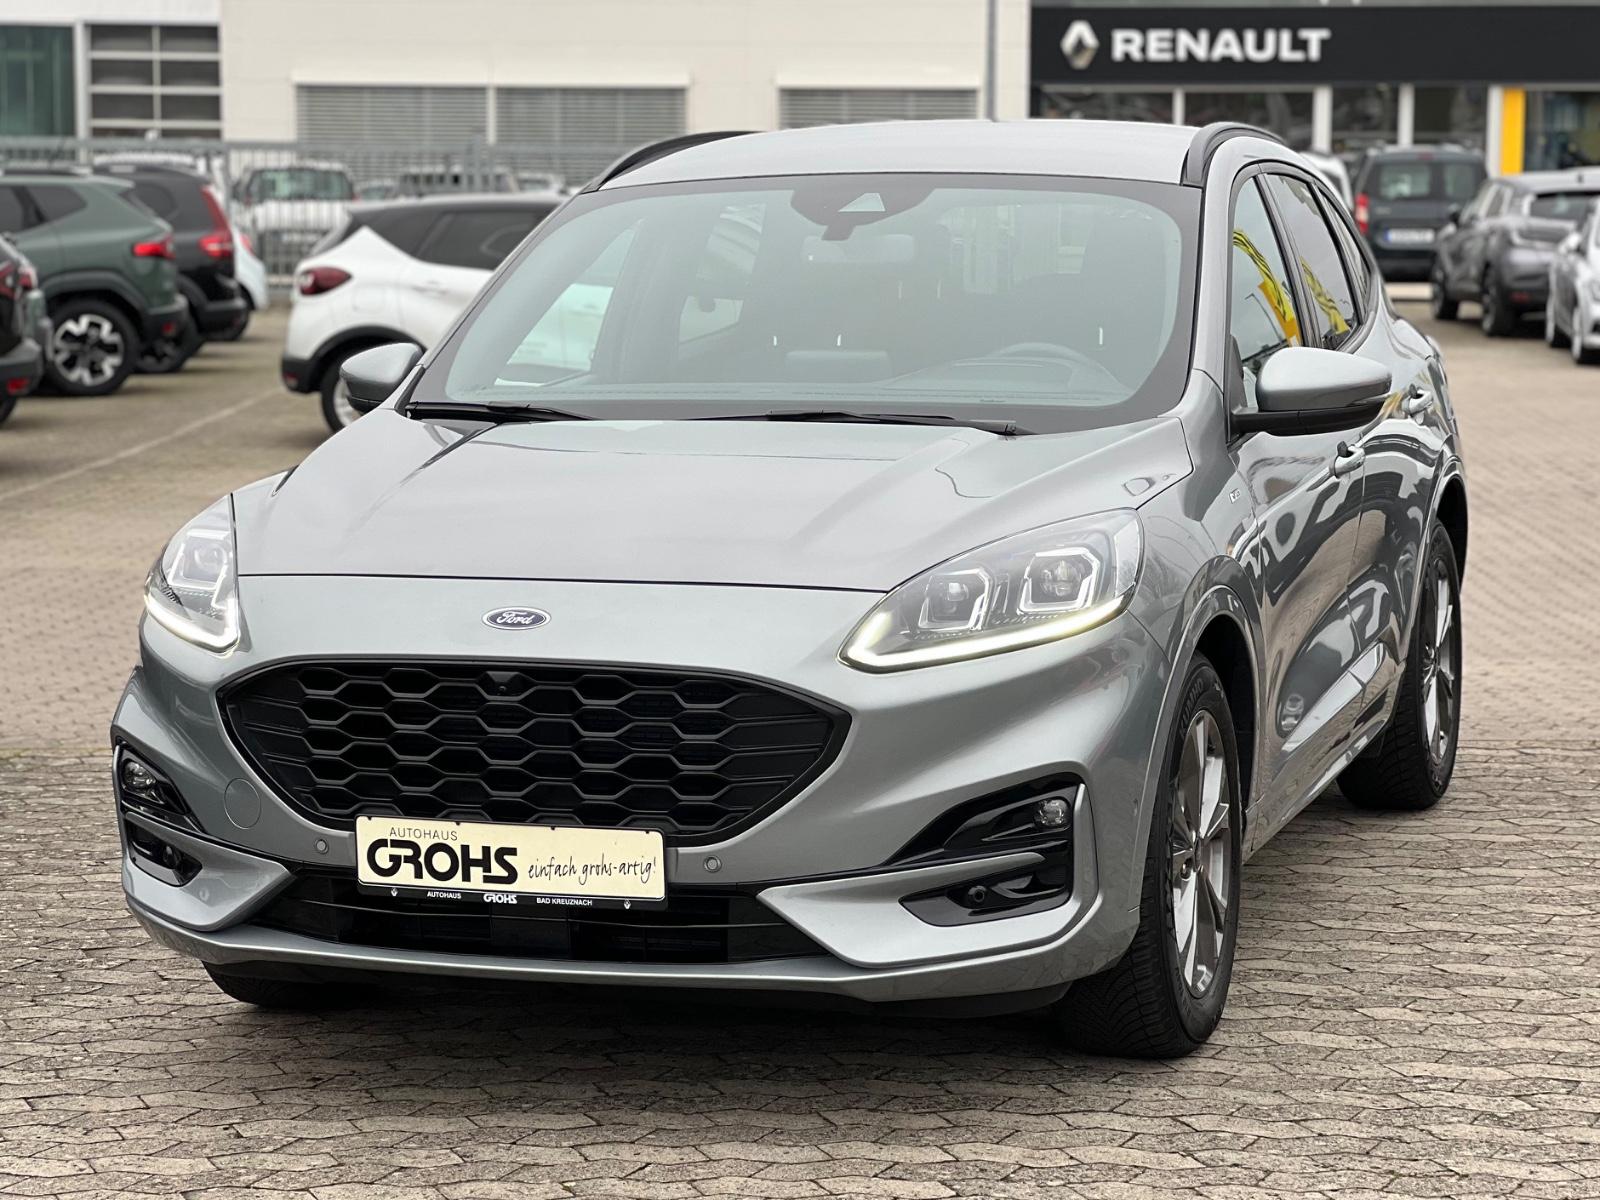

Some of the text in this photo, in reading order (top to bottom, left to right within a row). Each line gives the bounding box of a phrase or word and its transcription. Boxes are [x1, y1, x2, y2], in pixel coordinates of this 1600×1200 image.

[1111, 29, 1331, 62] RENAULT
[496, 611, 536, 625] Ford
[389, 827, 458, 841] AUTOHAUS
[367, 838, 518, 885] GROHS
[528, 852, 657, 885] einfach grohs-artig!
[427, 891, 461, 899] AUTOHAUS
[483, 893, 517, 904] GROHS
[552, 898, 593, 906] KREUZNACH
